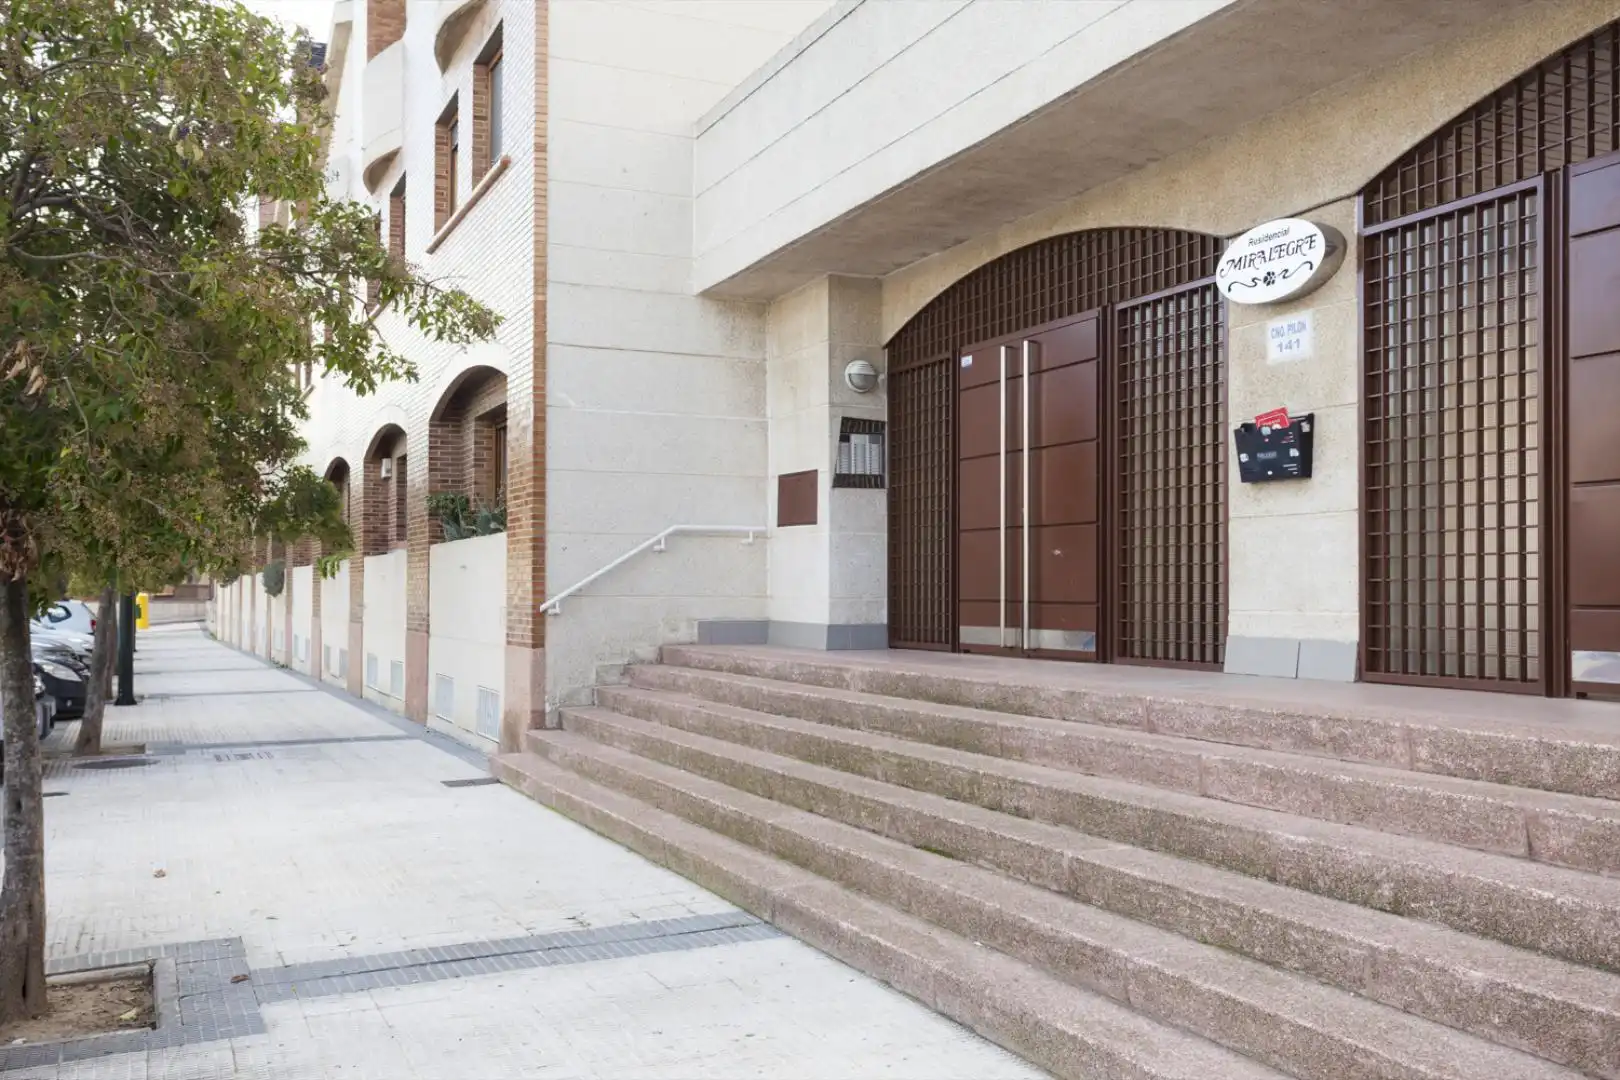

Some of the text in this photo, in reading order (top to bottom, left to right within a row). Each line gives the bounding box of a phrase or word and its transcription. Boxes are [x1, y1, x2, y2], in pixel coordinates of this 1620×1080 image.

[1248, 226, 1291, 247] Residencial
[1219, 233, 1318, 279] MIRALEGRE
[1276, 338, 1301, 352] 141
